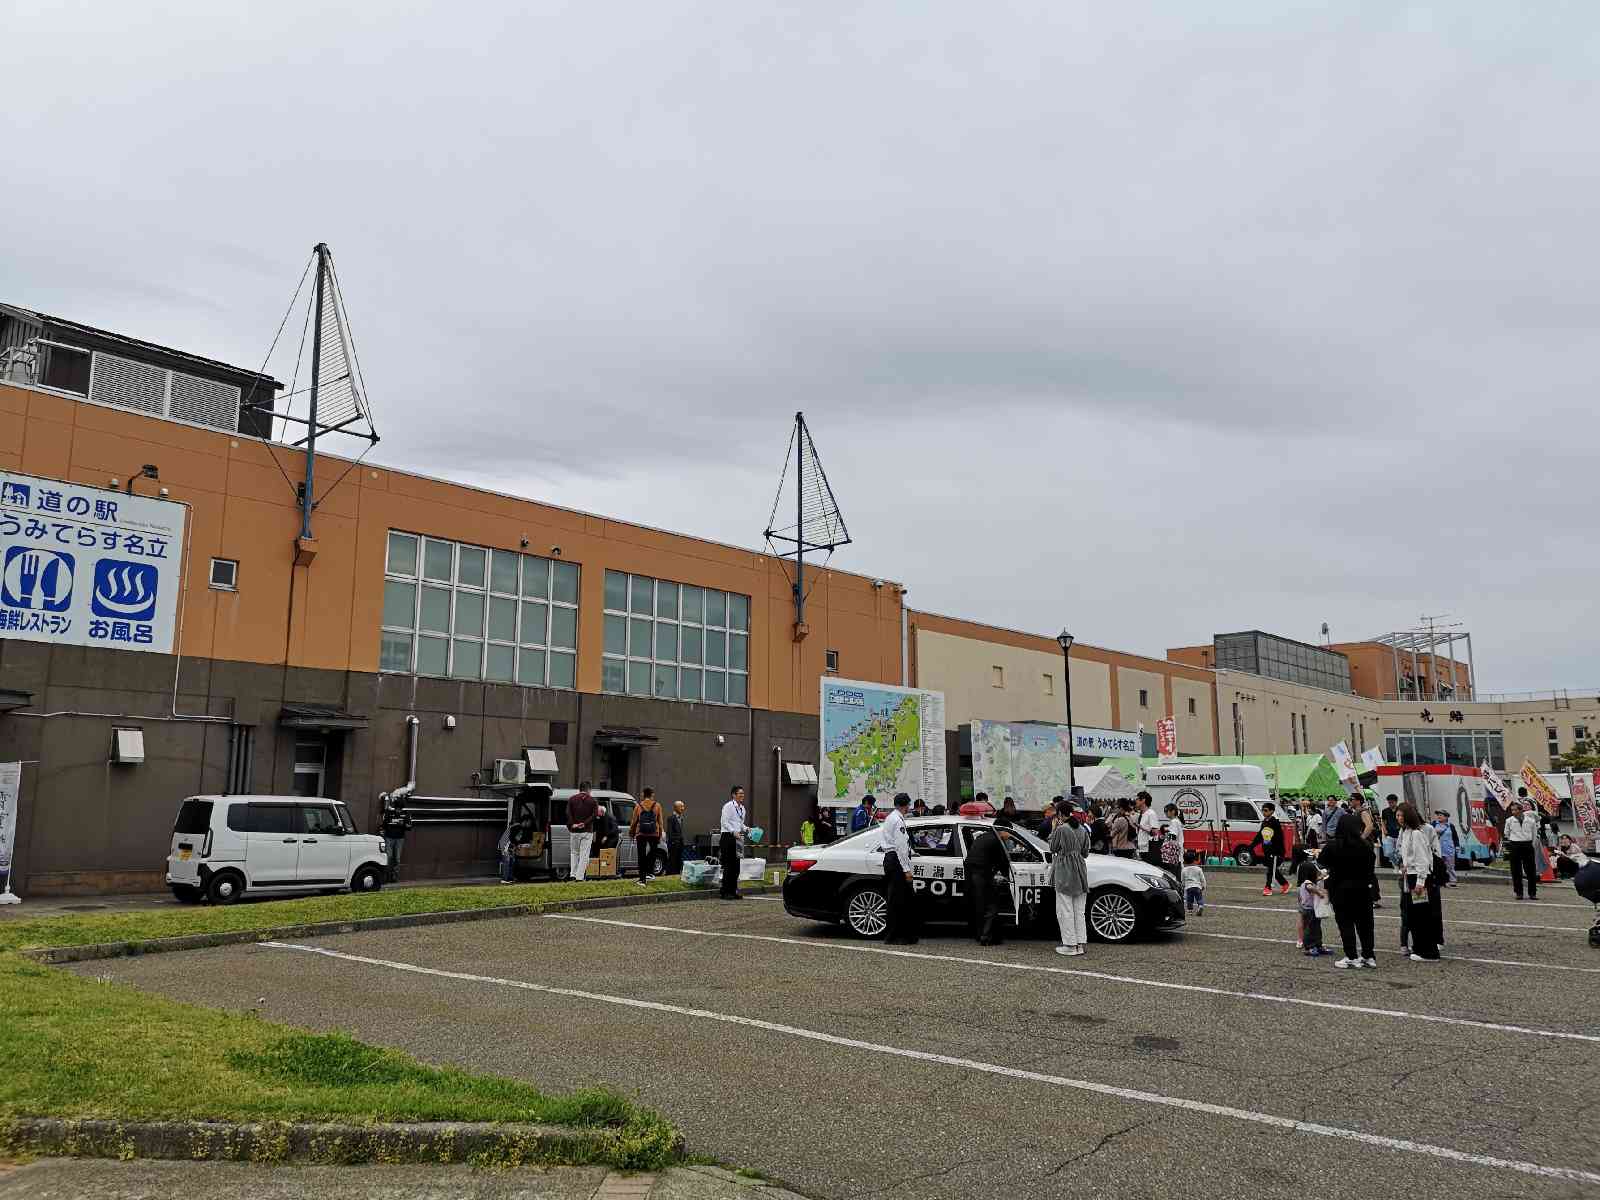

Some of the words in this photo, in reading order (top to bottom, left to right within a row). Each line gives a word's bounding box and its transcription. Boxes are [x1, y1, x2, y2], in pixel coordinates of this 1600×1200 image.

[37, 488, 118, 522] 道の駅
[0, 513, 168, 559] うみてらす名立
[88, 619, 153, 643] お風呂
[1076, 735, 1094, 748] 道の駅
[1199, 773, 1221, 781] KING
[913, 864, 964, 879] 新潟県
